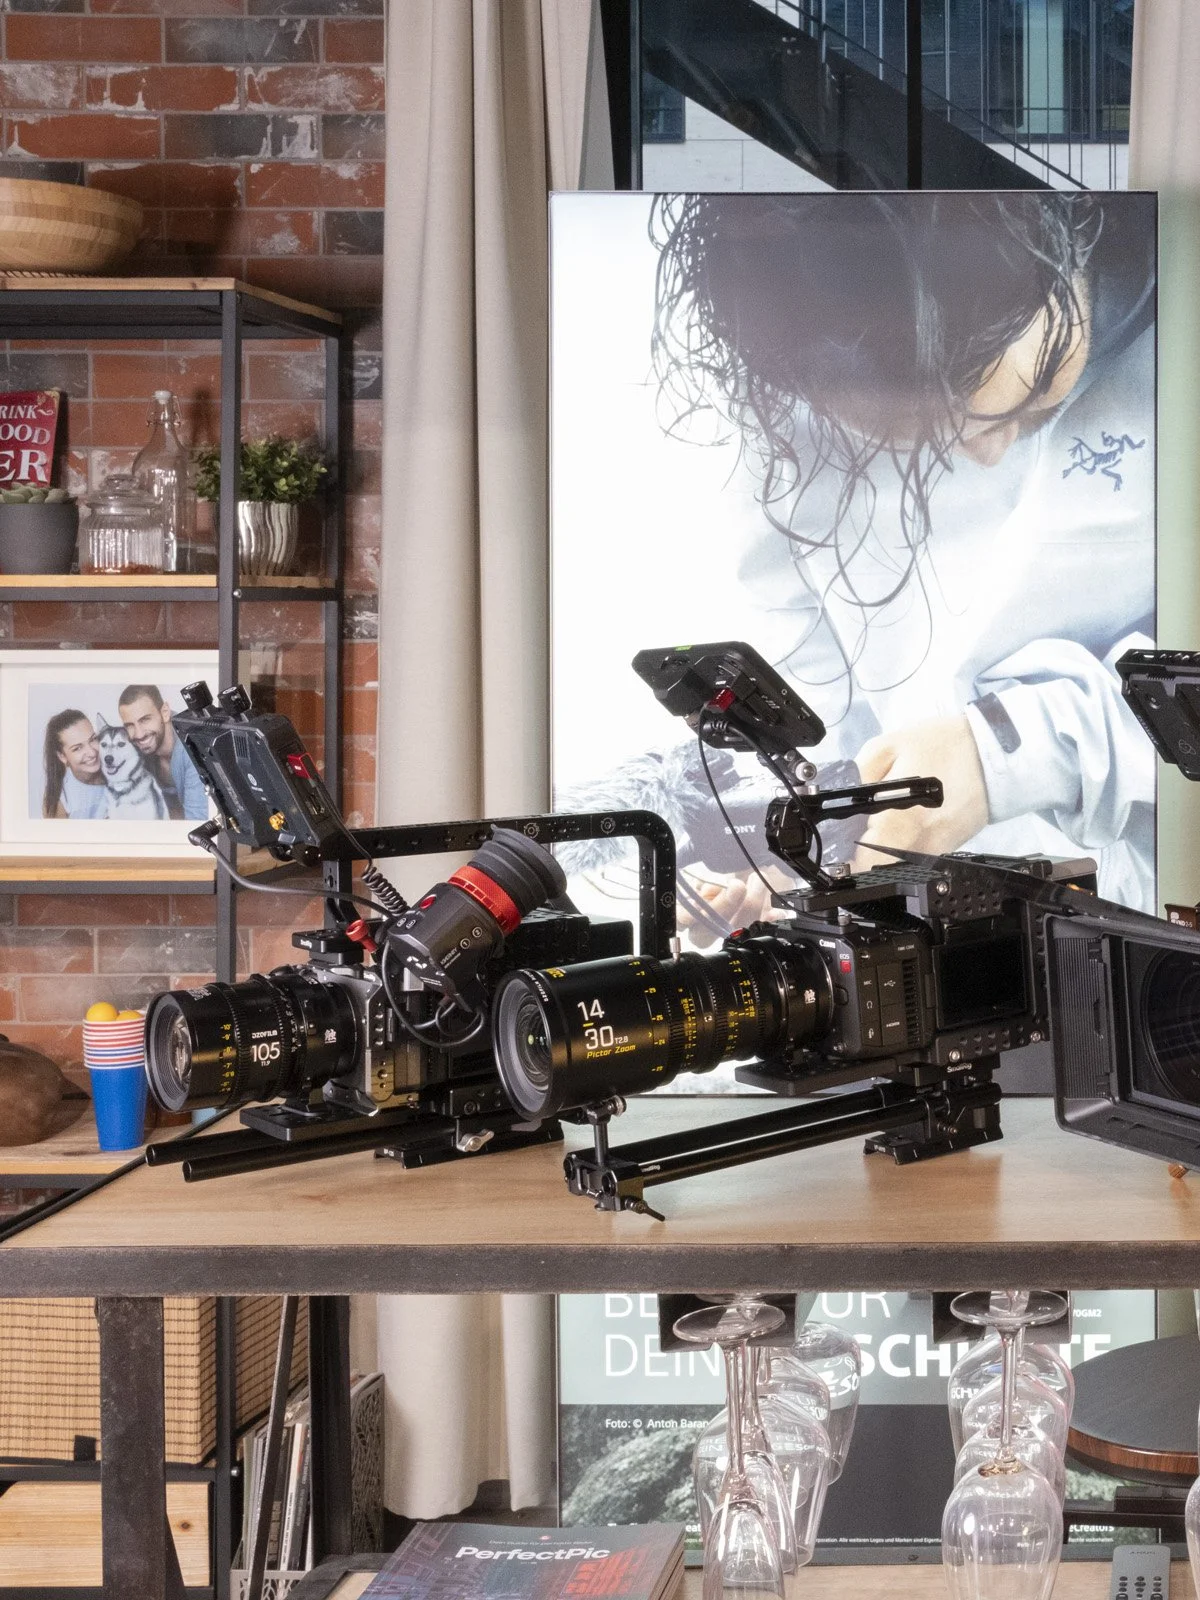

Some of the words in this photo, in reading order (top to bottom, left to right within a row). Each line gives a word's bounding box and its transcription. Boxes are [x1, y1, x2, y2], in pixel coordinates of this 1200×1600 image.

[0, 405, 38, 419] RINK
[0, 423, 50, 445] OOD
[0, 449, 48, 482] ER
[724, 825, 756, 835] SONY
[577, 999, 606, 1021] 14
[585, 1025, 614, 1050] 30
[615, 1035, 629, 1045] T2.8
[251, 1041, 281, 1063] 105
[586, 1048, 612, 1059] Pictor
[614, 1043, 637, 1054] Zoom
[821, 1293, 891, 1318] UR
[605, 1334, 720, 1377] DEIN
[605, 1418, 631, 1428] Foto:
[648, 1418, 678, 1428] Anton
[680, 1418, 709, 1428] Baran
[1069, 1524, 1114, 1532] eCreators
[455, 1546, 611, 1560] PerfectPic
